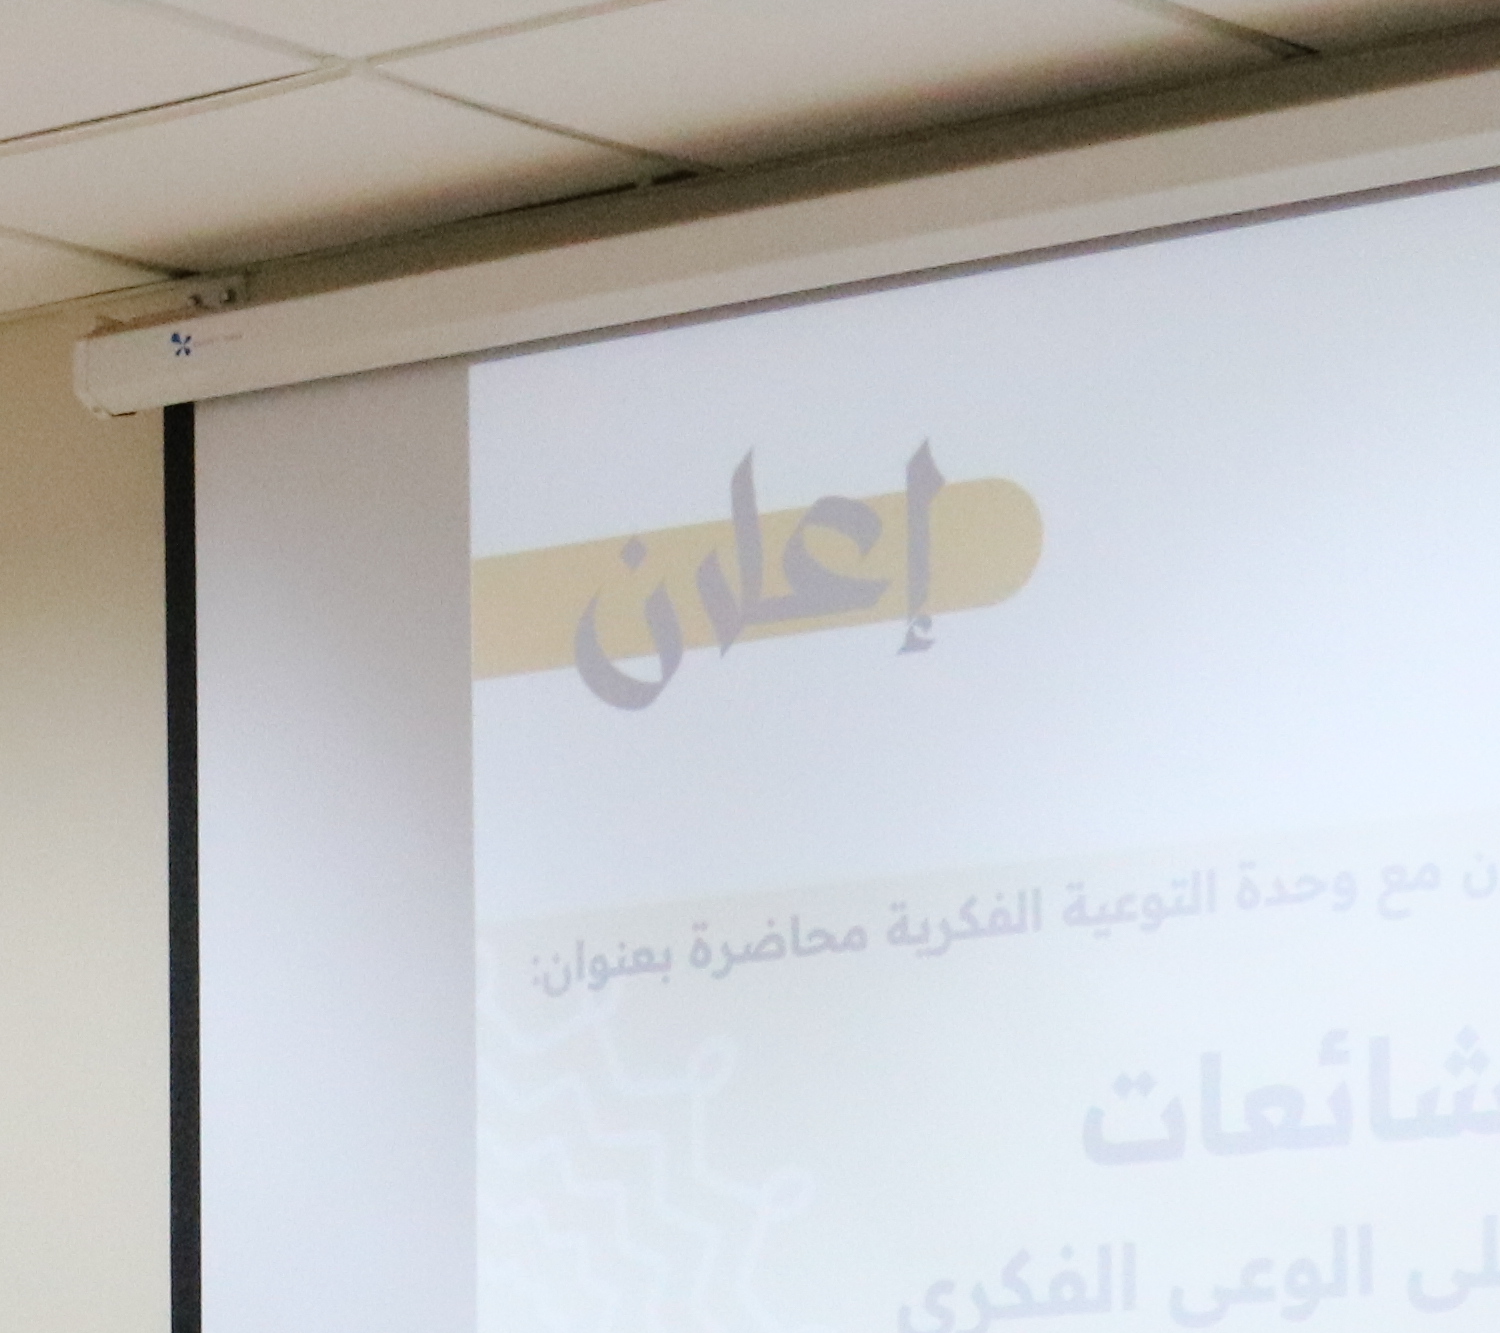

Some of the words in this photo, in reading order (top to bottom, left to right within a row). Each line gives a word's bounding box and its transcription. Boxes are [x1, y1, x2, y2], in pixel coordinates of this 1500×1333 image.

[574, 437, 945, 711] إعلان
[1062, 870, 1217, 939] التوعية
[1235, 862, 1358, 911] وحدة
[1377, 860, 1440, 917] مع
[689, 916, 868, 978] محاضرة
[885, 887, 1043, 958] الفكرية
[531, 942, 672, 997] بعنوان:
